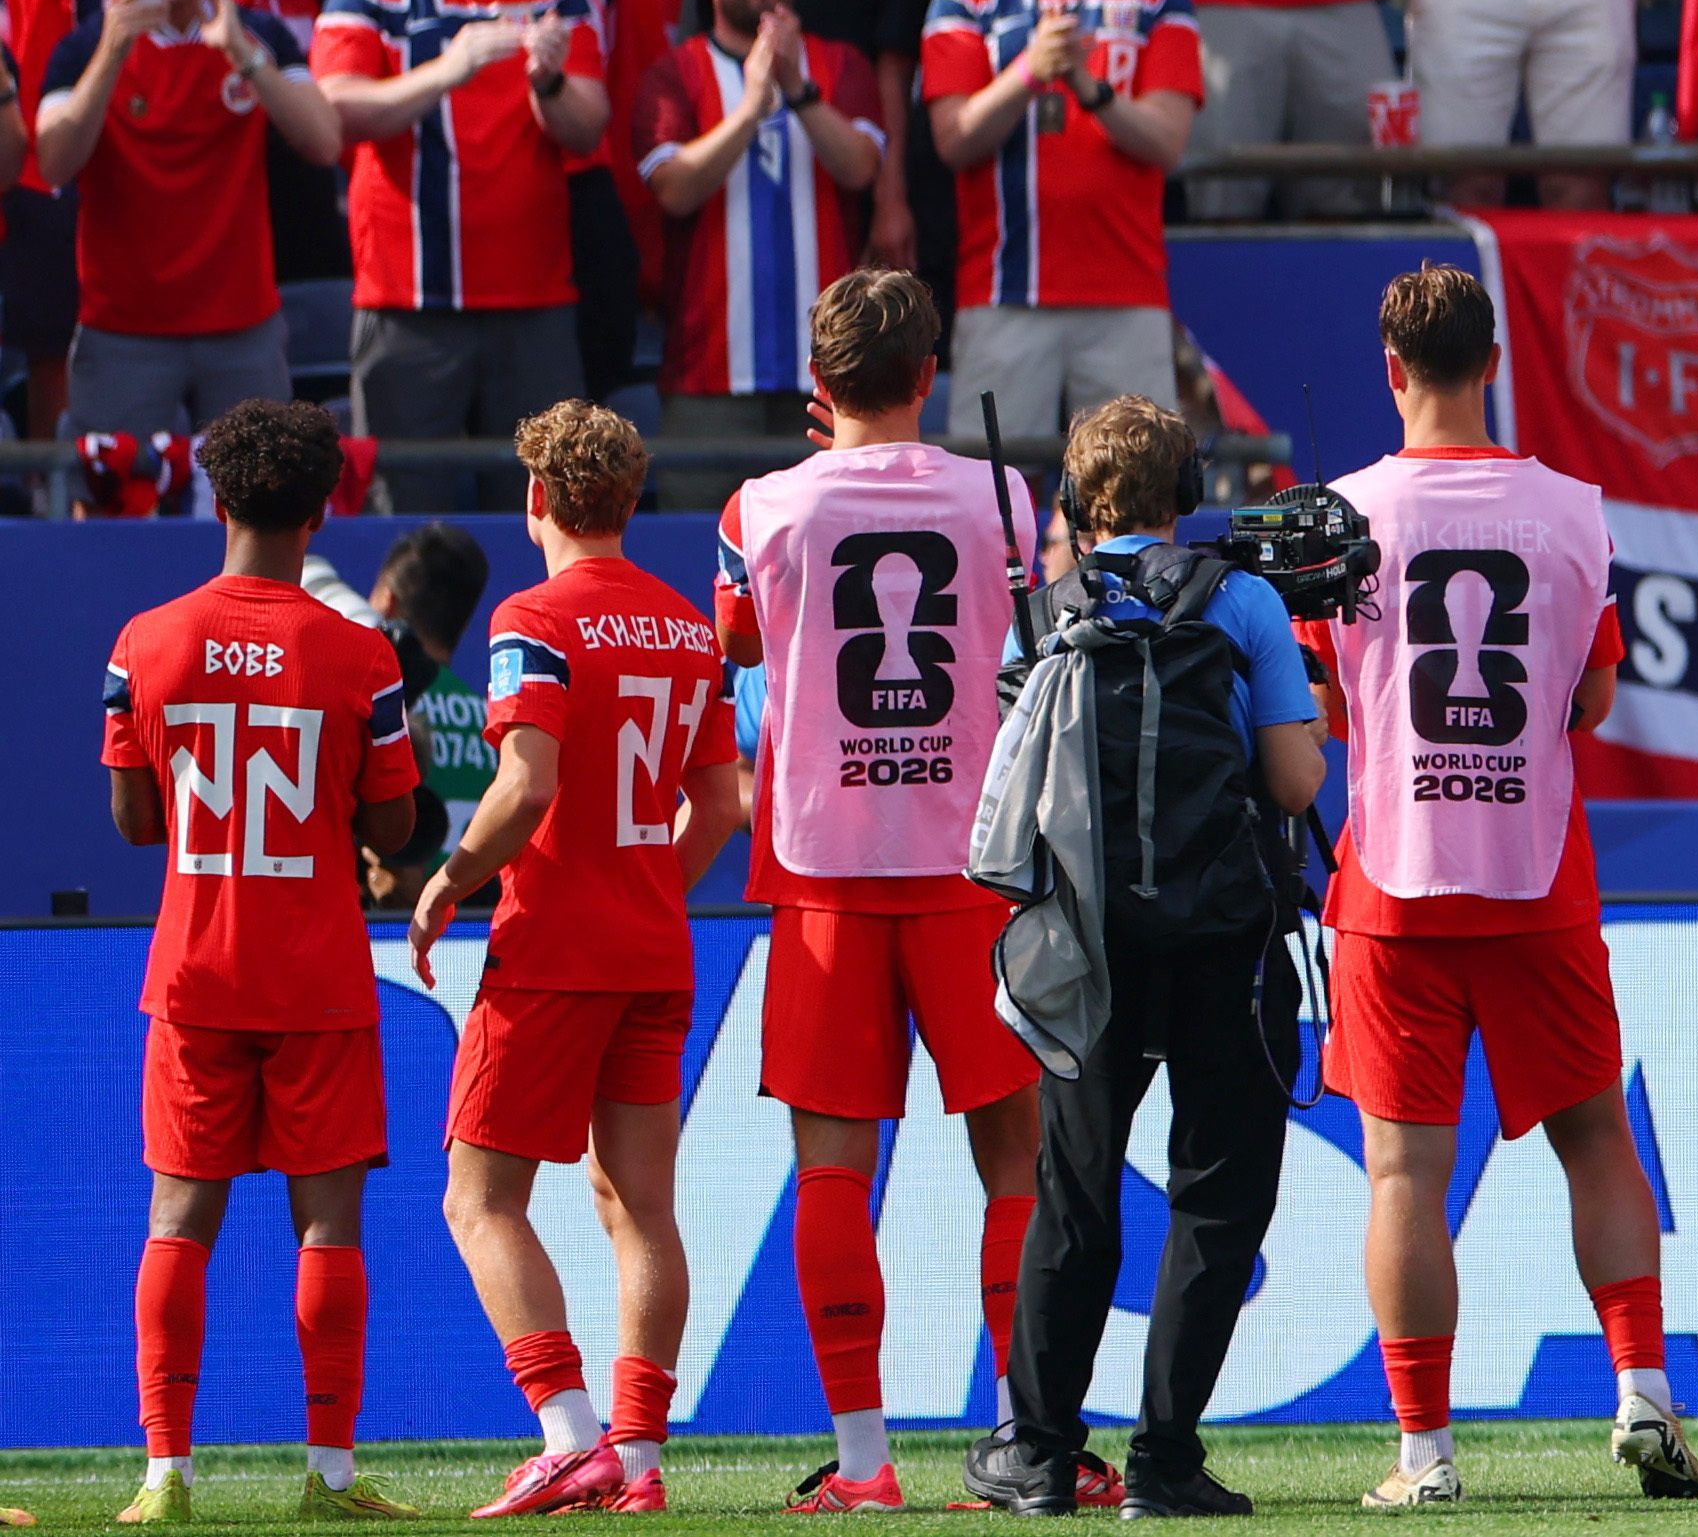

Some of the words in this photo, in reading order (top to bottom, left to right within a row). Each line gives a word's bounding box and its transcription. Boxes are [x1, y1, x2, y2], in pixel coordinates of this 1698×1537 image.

[1324, 560, 1348, 580] HOLD
[576, 613, 717, 658] SCHJELDERUP
[1630, 571, 1698, 688] S
[204, 638, 285, 678] BOBB
[871, 689, 928, 711] FIFA
[1445, 706, 1495, 729] FIFA
[840, 737, 915, 756] WORLD
[918, 735, 954, 754] CUP
[840, 757, 954, 788] 2026
[1412, 753, 1484, 771] WORLD
[1485, 754, 1527, 772] CUP
[162, 702, 325, 879] 22
[1413, 774, 1527, 805] 2026
